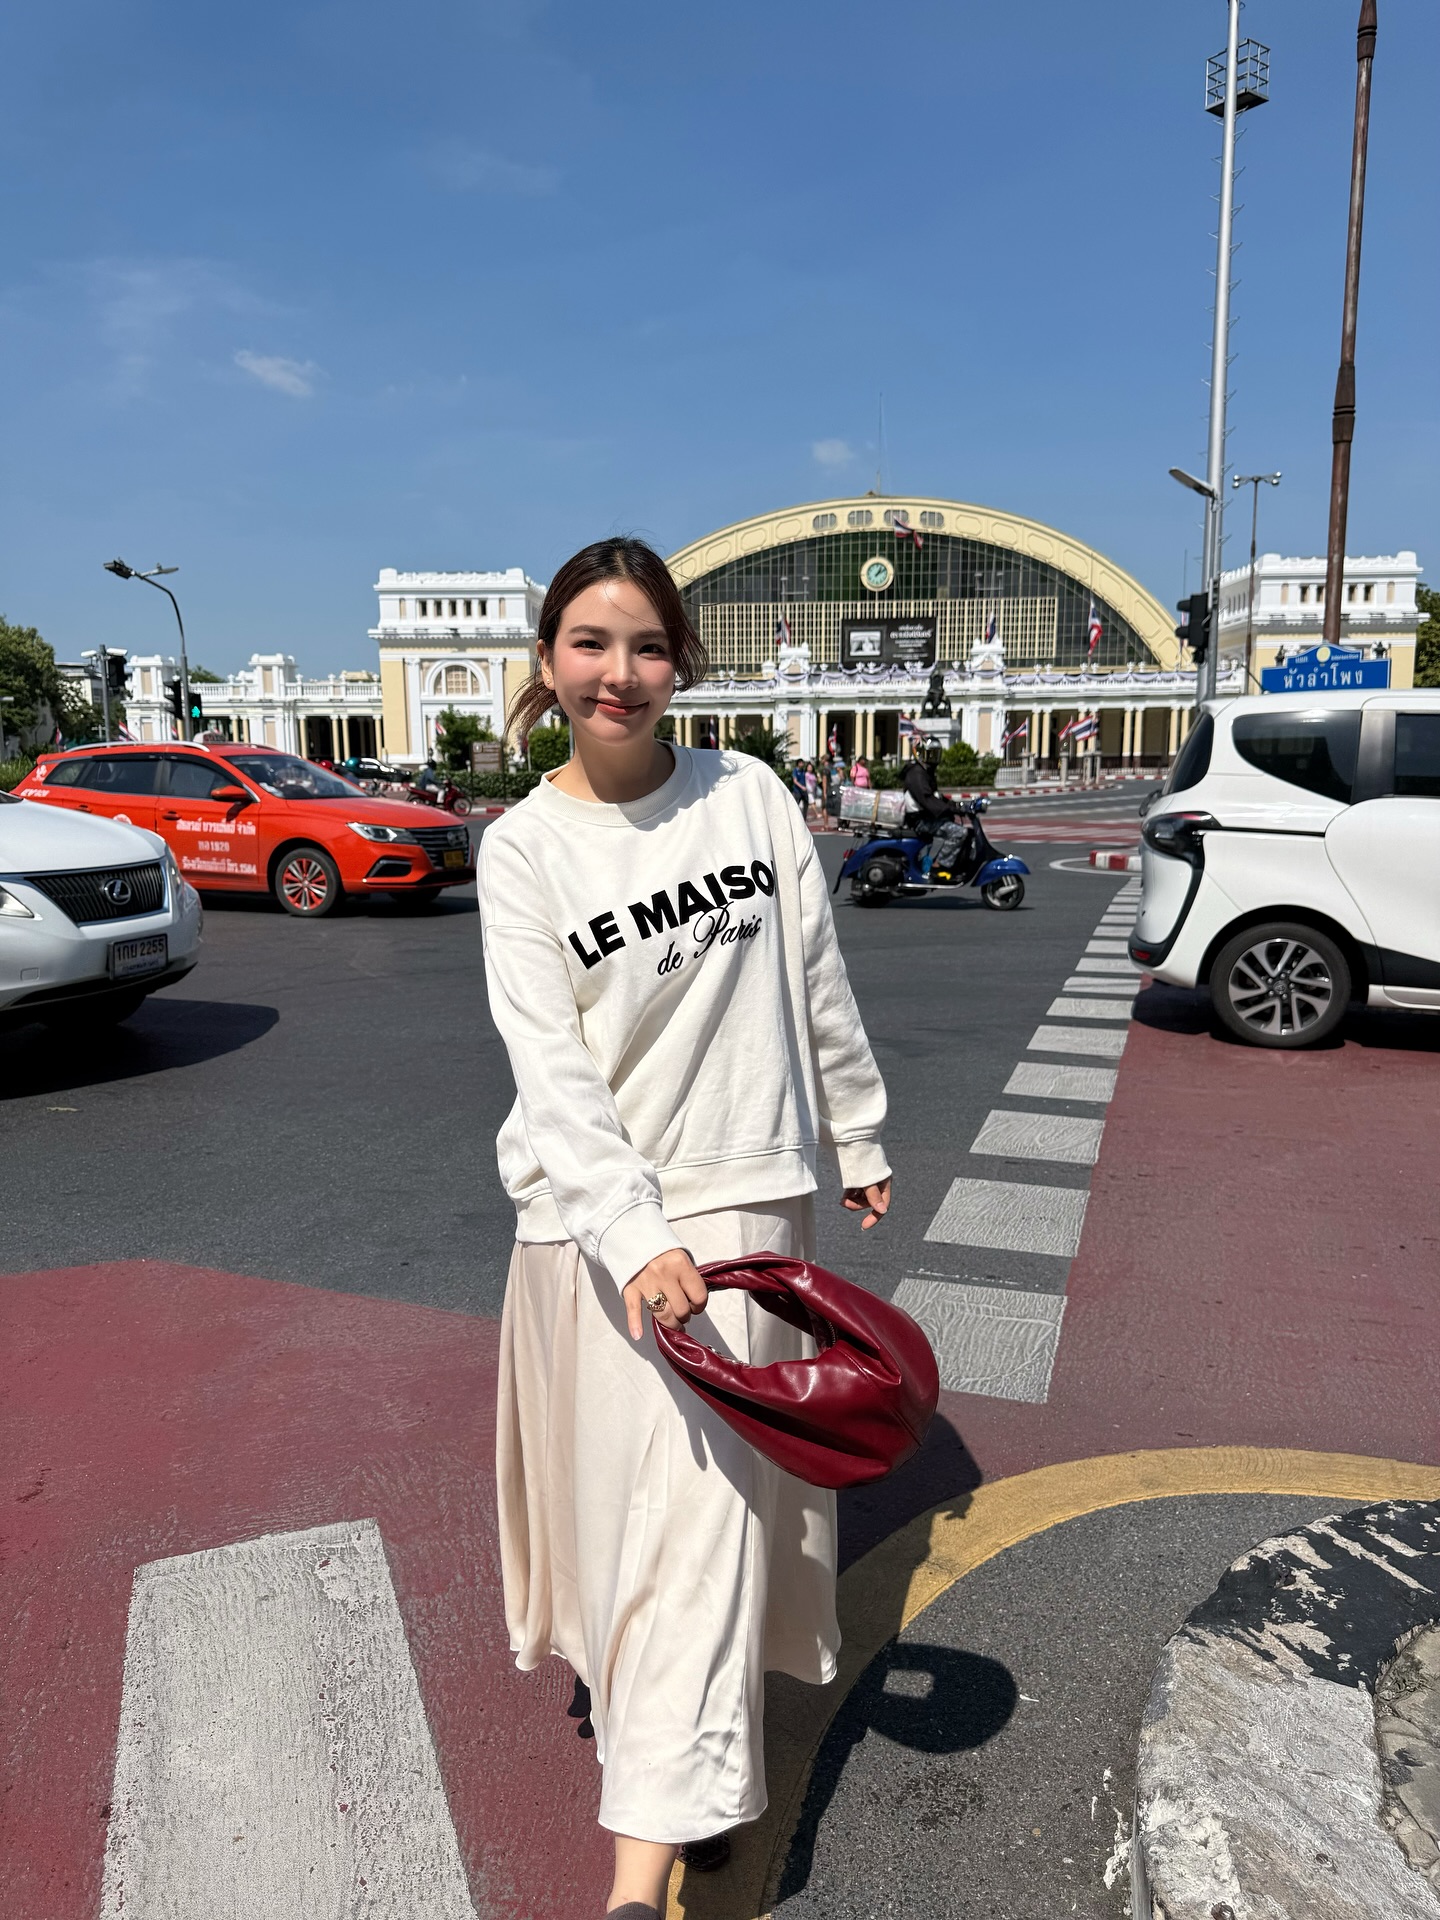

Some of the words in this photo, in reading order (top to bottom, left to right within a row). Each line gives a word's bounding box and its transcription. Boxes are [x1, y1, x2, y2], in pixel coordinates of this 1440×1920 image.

[1283, 662, 1363, 689] หัวลำโพง
[567, 910, 627, 970] LE
[628, 860, 776, 940] MAISO
[656, 941, 685, 976] de
[693, 901, 763, 959] Paris
[140, 939, 165, 957] 2255
